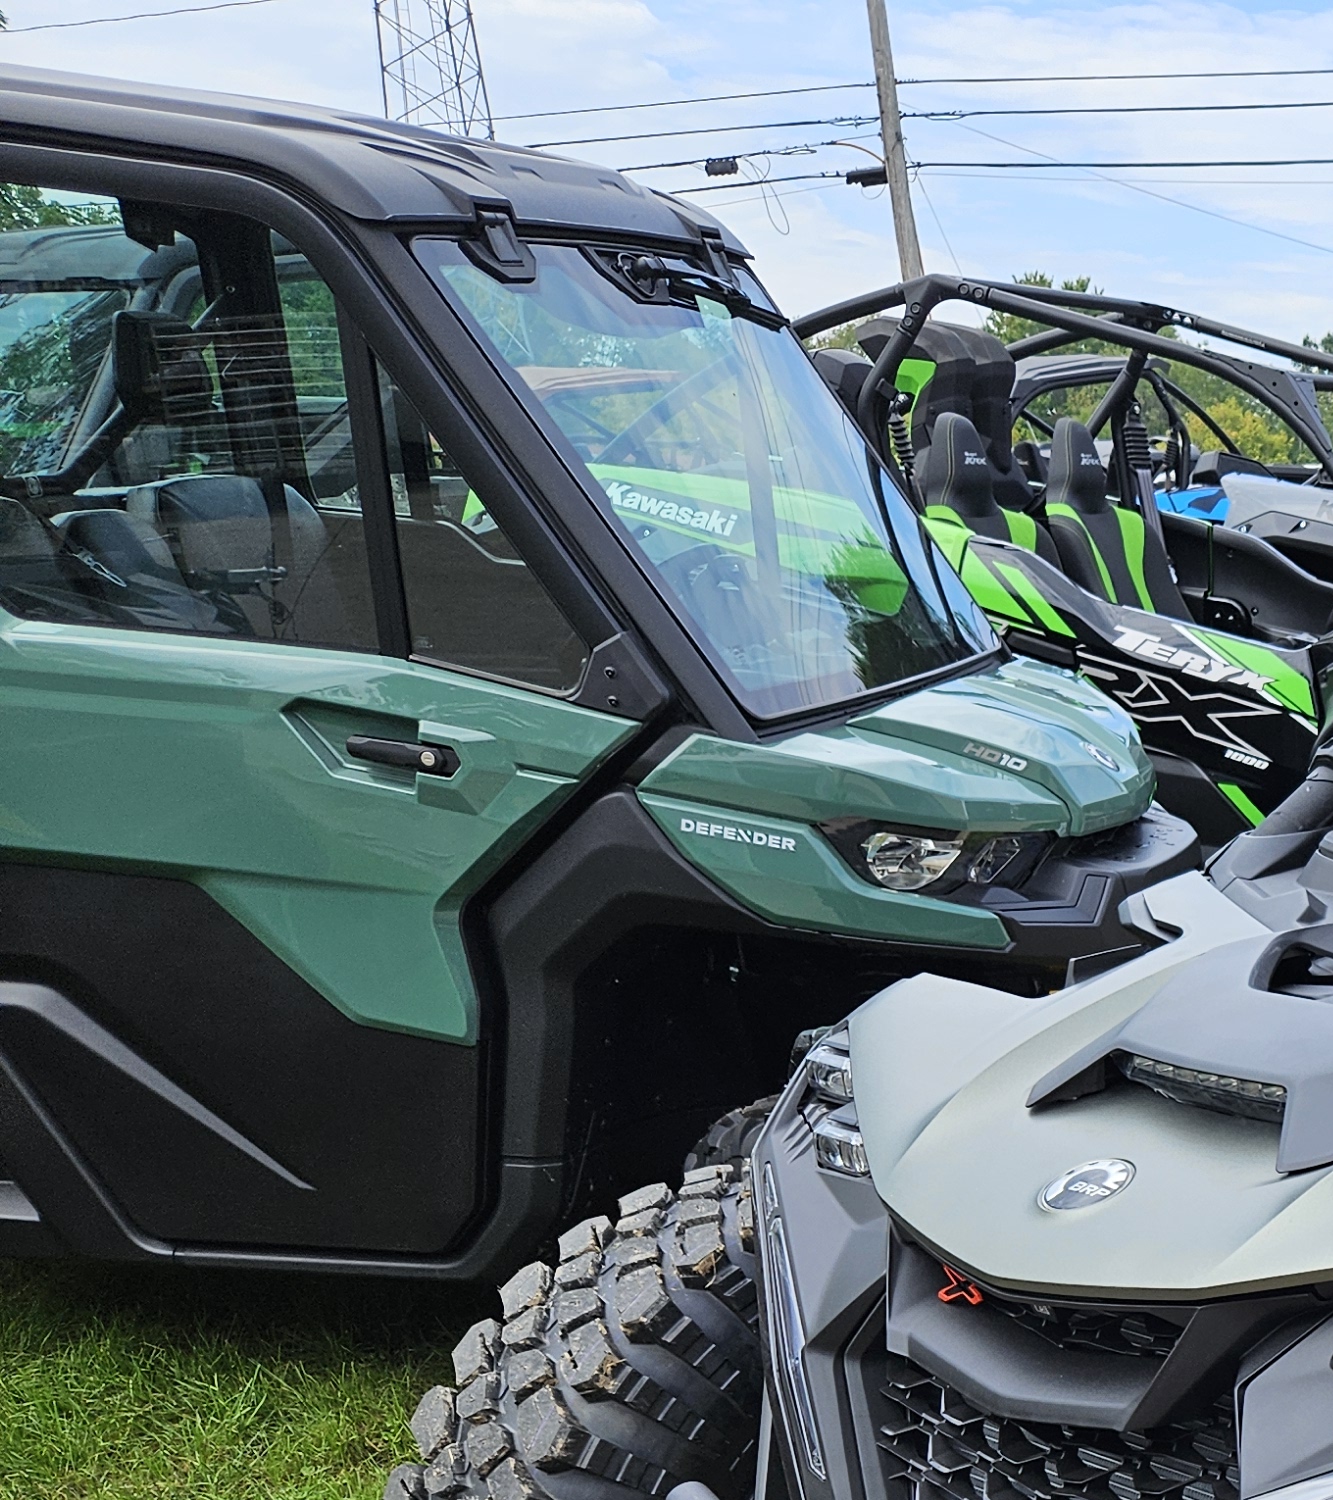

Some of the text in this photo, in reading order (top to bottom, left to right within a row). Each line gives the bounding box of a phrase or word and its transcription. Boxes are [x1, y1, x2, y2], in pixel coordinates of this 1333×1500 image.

[605, 481, 738, 537] Kawasaki
[1112, 625, 1280, 692] TERYX
[962, 742, 1028, 772] HD10
[1223, 749, 1270, 771] 1000
[680, 818, 797, 852] DEFENDER
[1067, 1181, 1112, 1197] BRP
